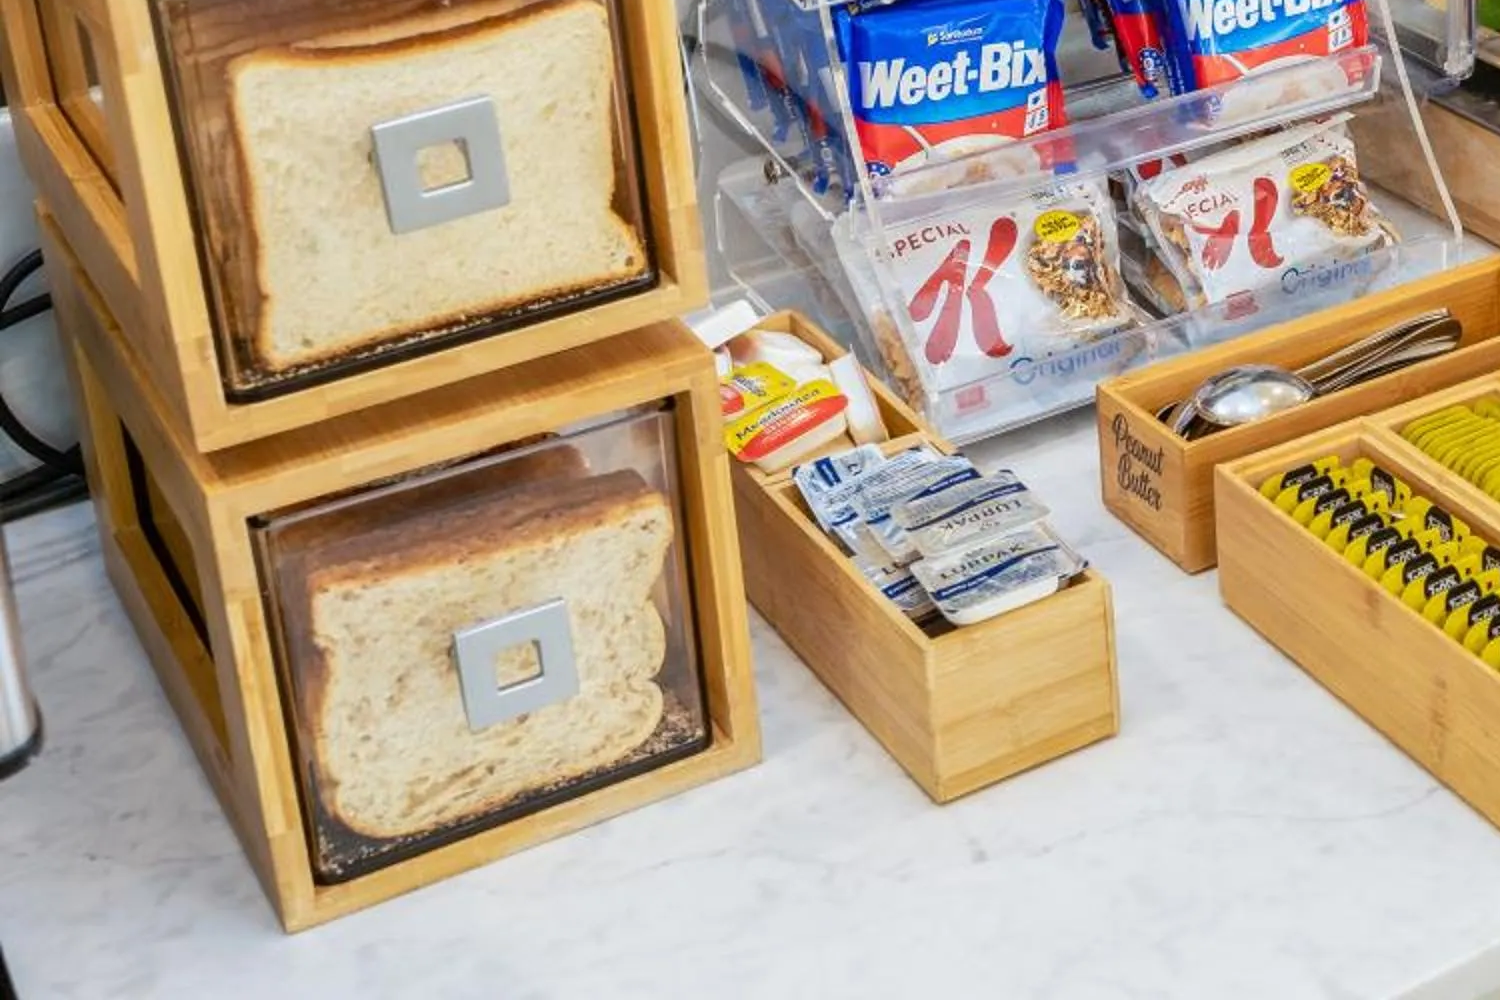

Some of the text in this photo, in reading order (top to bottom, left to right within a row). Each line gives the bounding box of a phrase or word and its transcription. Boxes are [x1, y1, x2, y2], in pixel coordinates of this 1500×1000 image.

[858, 40, 1046, 109] Weet-Bix
[889, 222, 970, 259] PECIAL
[907, 215, 1018, 365] K
[1009, 340, 1120, 385] Original
[1112, 412, 1164, 476] Peanut
[1118, 453, 1162, 512] Butter
[939, 542, 1023, 579] LURPAK
